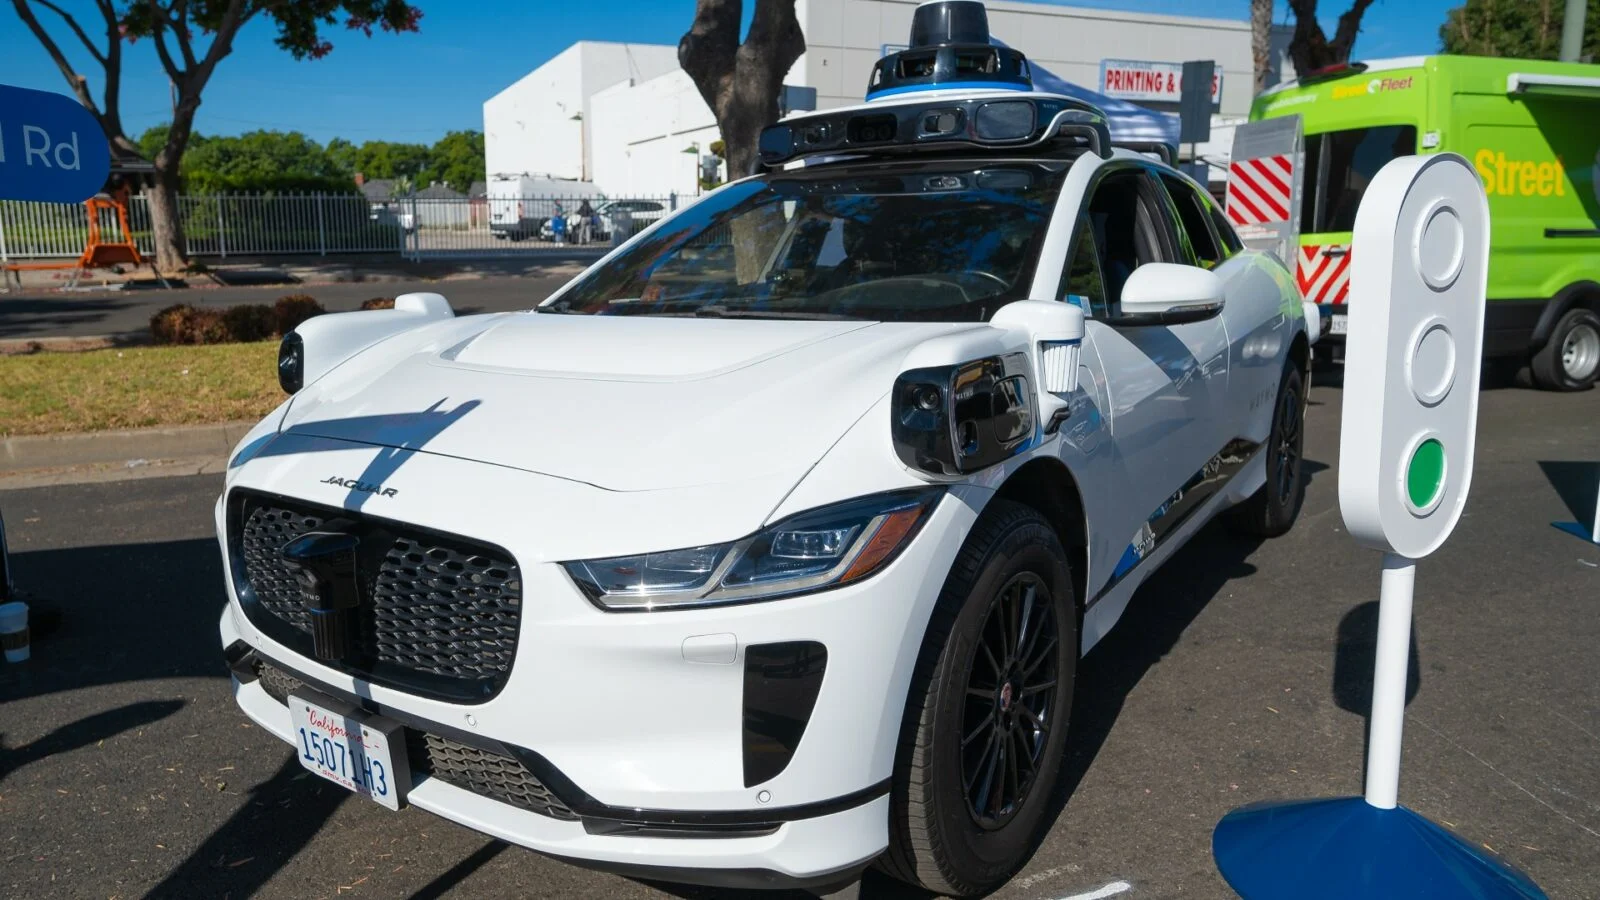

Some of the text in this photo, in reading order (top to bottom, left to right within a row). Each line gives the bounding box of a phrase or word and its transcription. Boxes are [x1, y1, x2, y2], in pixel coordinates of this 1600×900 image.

[1106, 69, 1163, 92] PRINTING
[1167, 73, 1175, 93] &
[1380, 76, 1413, 92] Fleet
[23, 125, 80, 171] Rd
[1474, 149, 1566, 197] Street
[320, 476, 398, 498] JAGUAR
[309, 710, 371, 749] California
[300, 727, 388, 796] 15071H3
